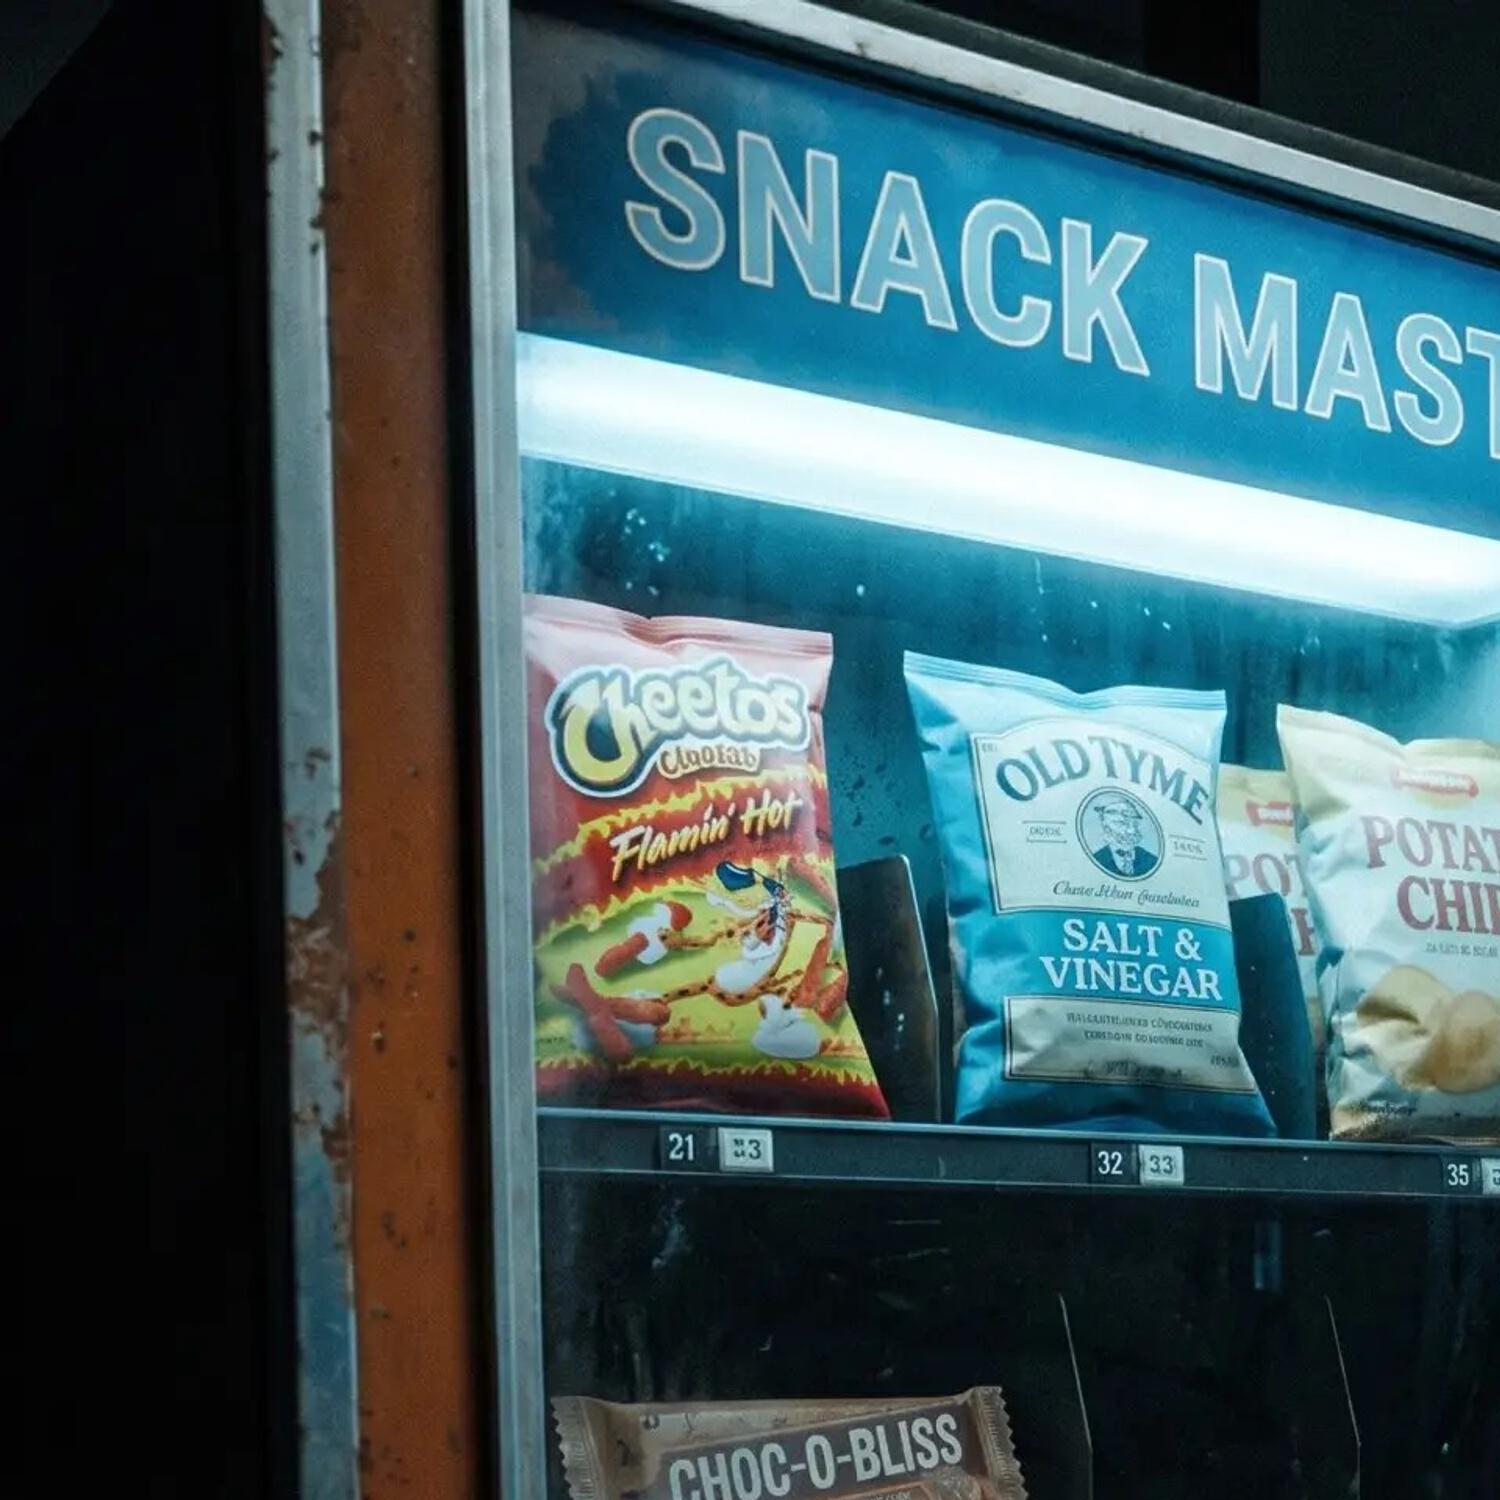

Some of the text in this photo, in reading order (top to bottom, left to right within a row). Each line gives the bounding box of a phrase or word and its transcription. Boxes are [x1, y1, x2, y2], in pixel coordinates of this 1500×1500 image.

[624, 107, 1150, 378] SNACK
[552, 660, 807, 791] Cheetos
[996, 736, 1209, 827] OLD TYME
[609, 788, 804, 883] Flamin' Hot
[1063, 918, 1203, 961] SALT &
[1039, 956, 1224, 1002] VINEGAR
[668, 1132, 695, 1161] 21
[1097, 1150, 1123, 1175] 32
[1446, 1163, 1469, 1186] 35
